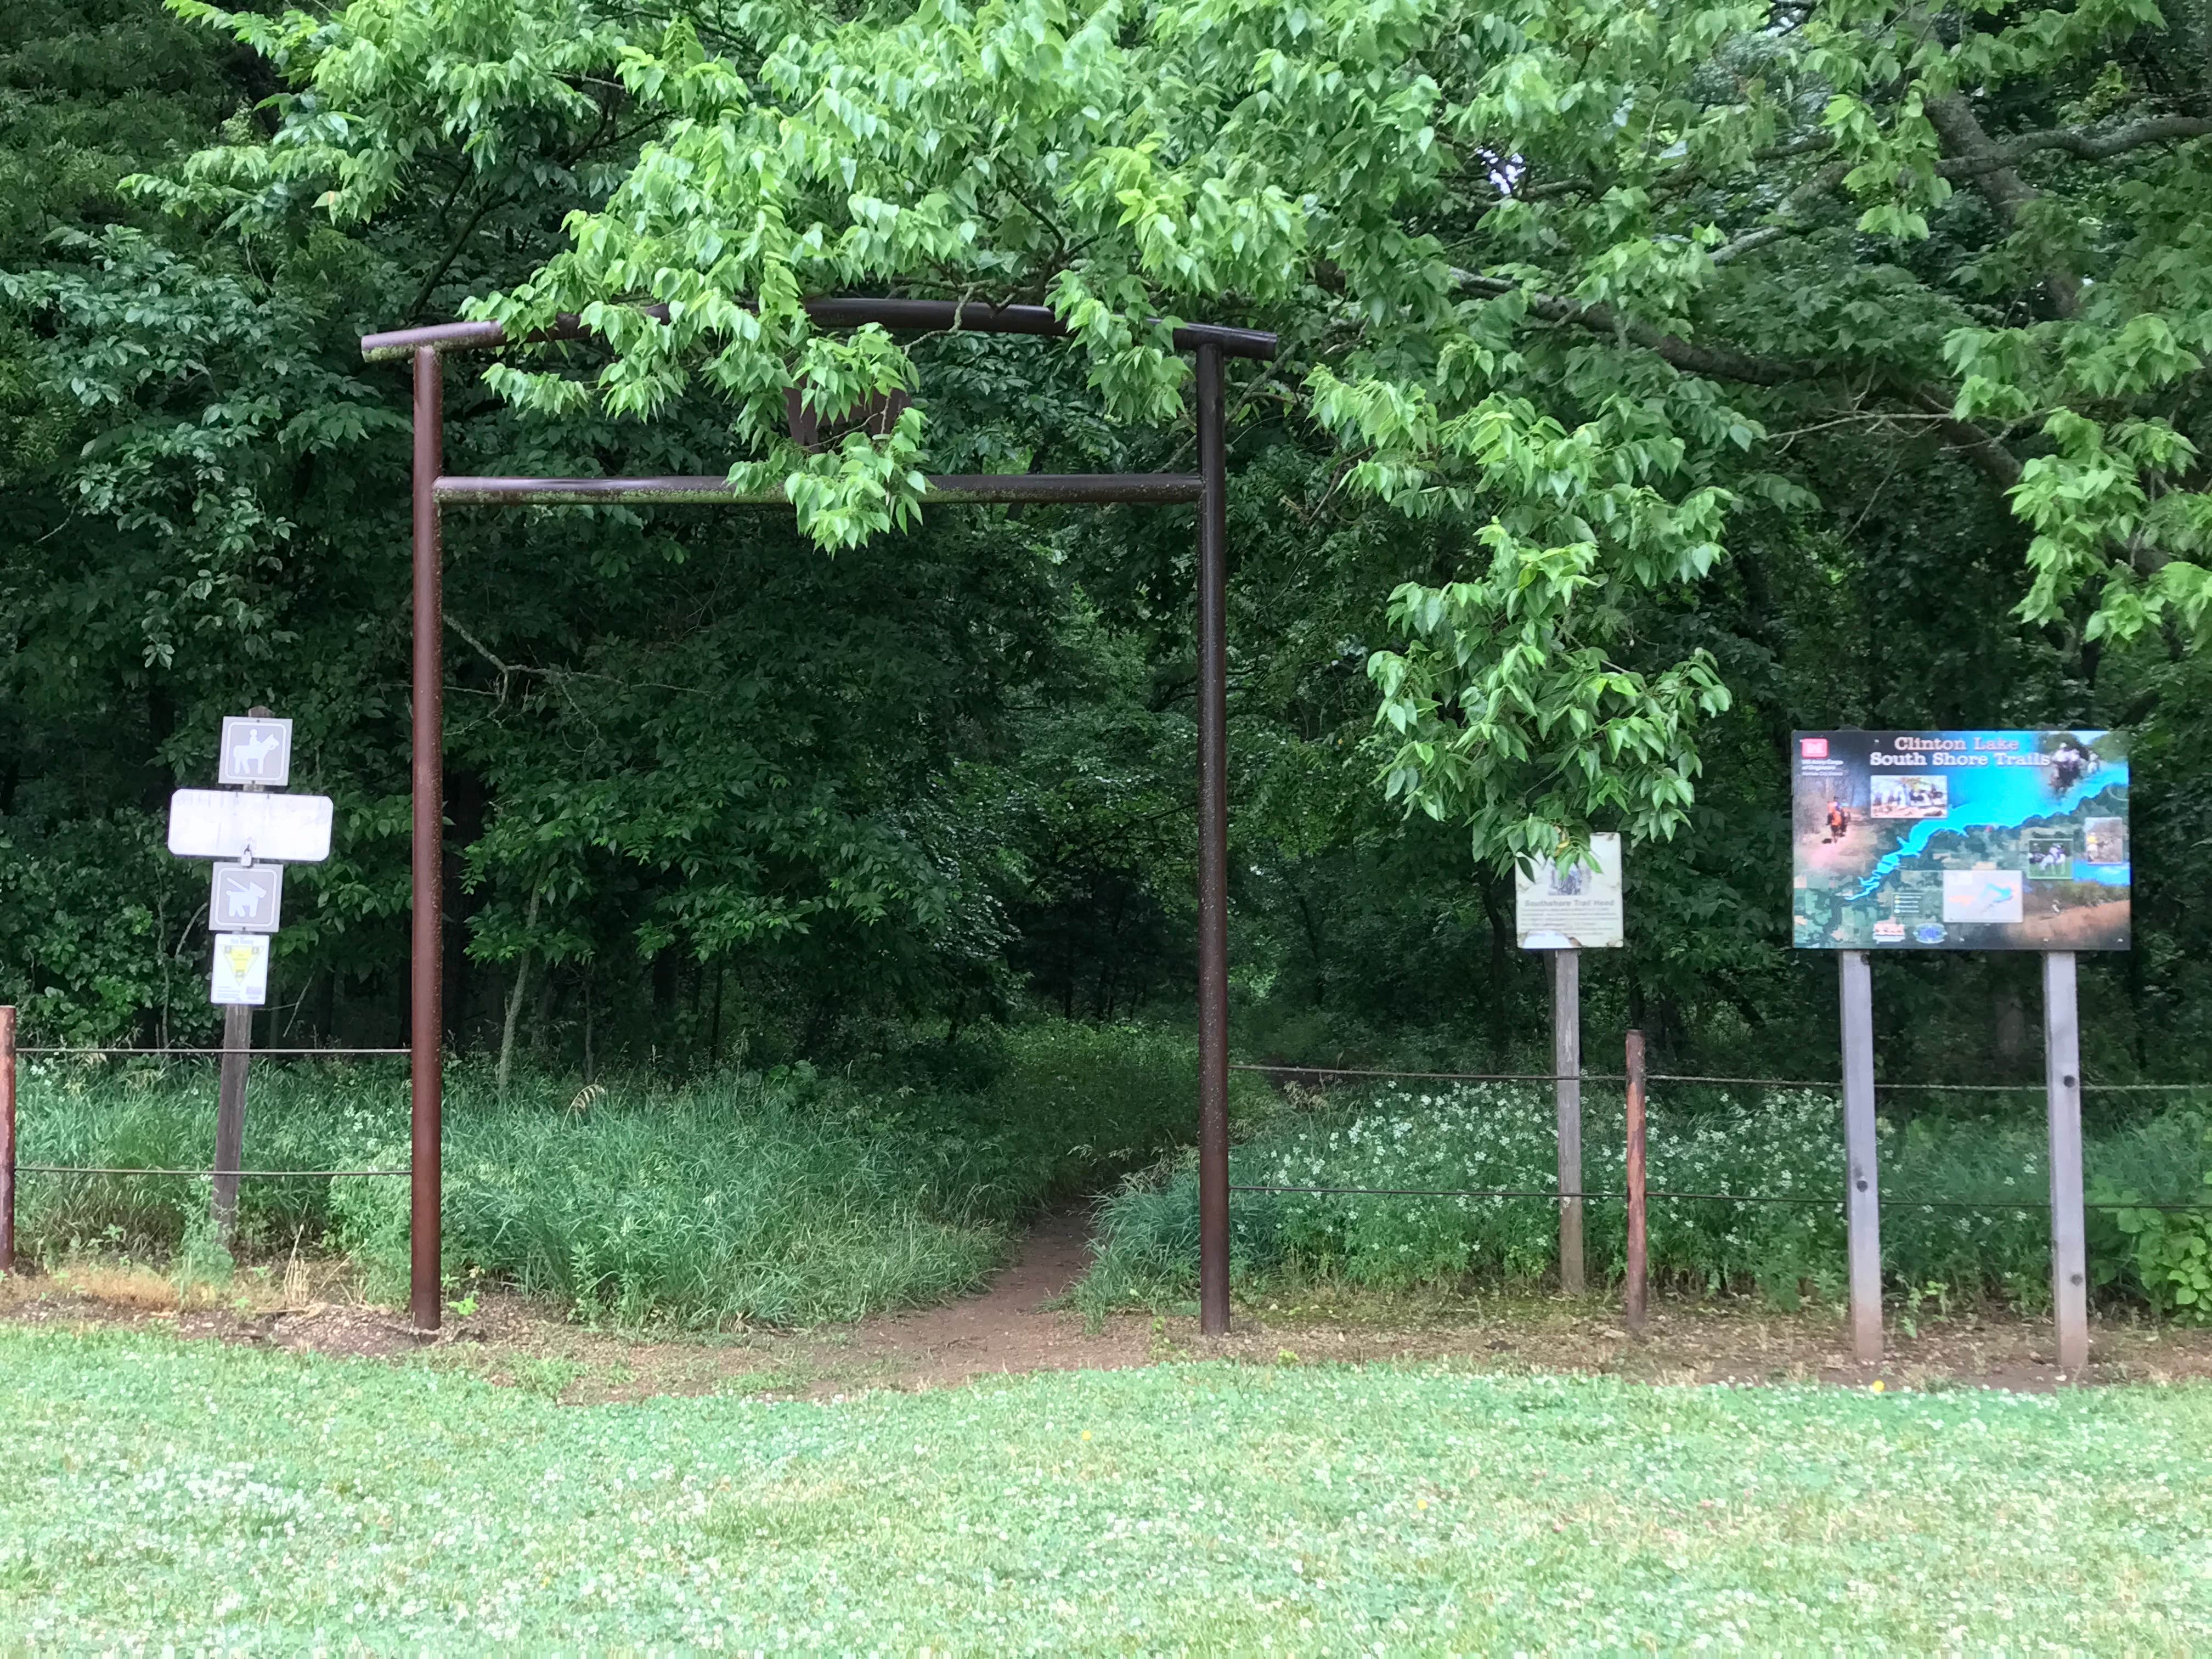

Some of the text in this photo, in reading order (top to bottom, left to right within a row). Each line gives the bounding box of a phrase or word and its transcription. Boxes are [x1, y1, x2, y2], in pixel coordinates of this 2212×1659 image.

[1894, 737, 2019, 751] Clinton Lake
[1870, 752, 2051, 765] South Shore Trails
